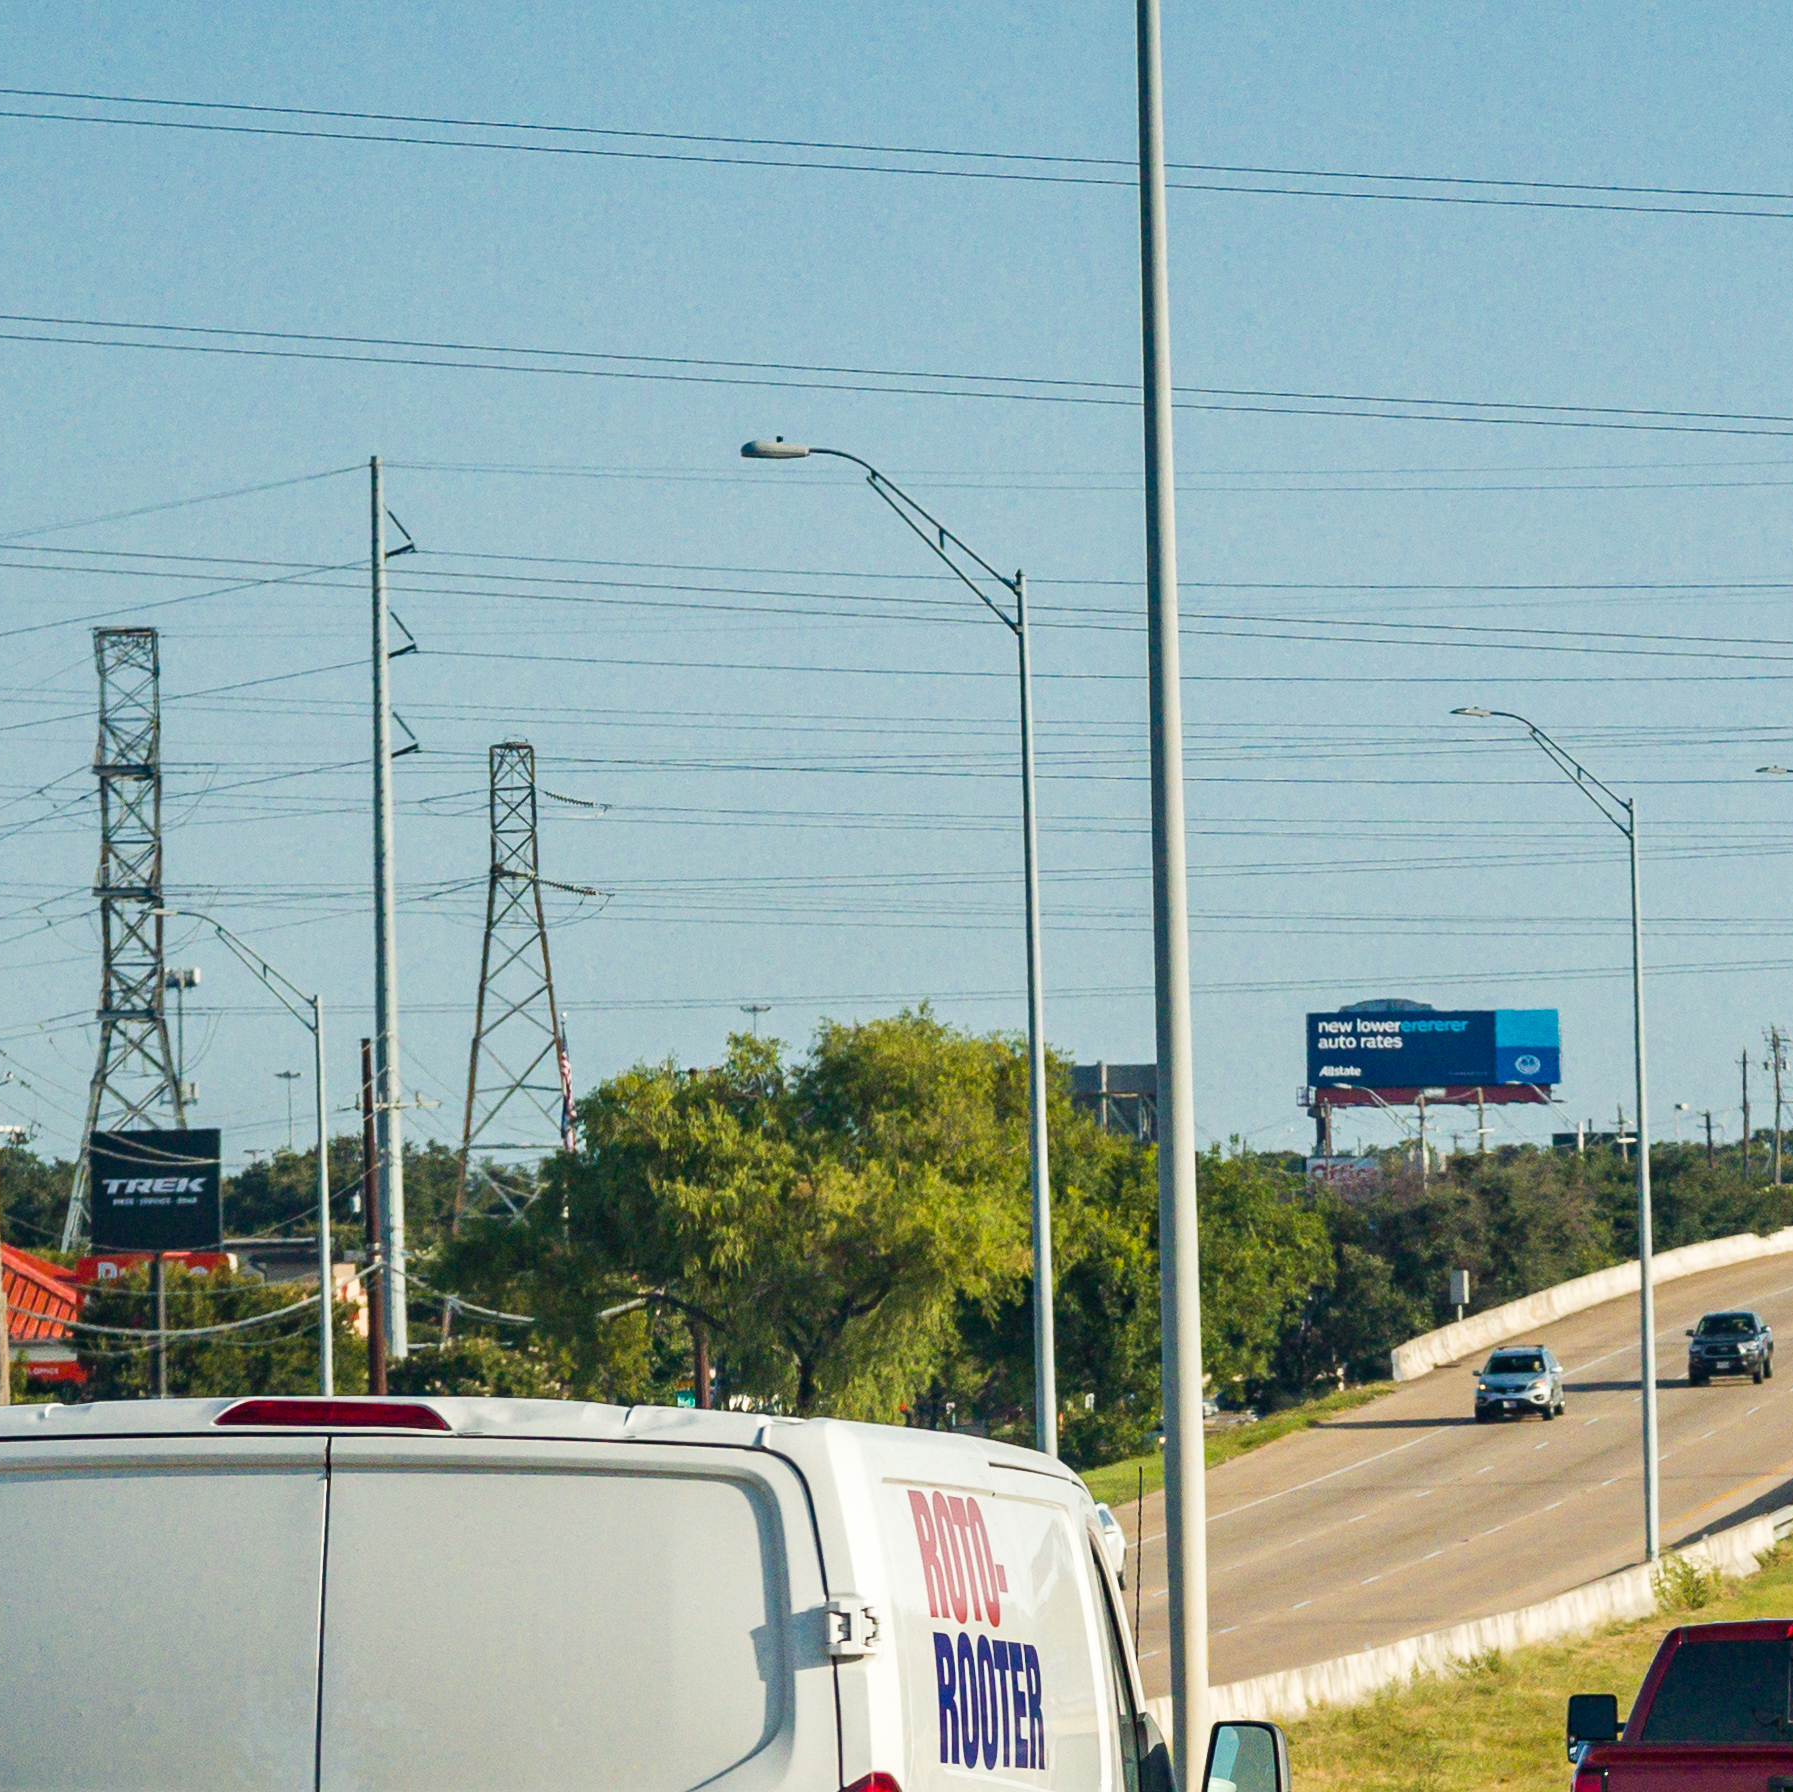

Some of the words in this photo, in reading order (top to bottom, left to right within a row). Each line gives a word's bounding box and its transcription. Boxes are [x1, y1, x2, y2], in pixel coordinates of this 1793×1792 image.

[1318, 1019, 1352, 1033] new
[1318, 1034, 1356, 1049] auto
[1360, 1035, 1403, 1049] rates
[1319, 1065, 1361, 1077] Allstate
[102, 1177, 207, 1194] TREK
[907, 1490, 1008, 1628] ROTO-
[933, 1631, 1046, 1770] ROOTER
